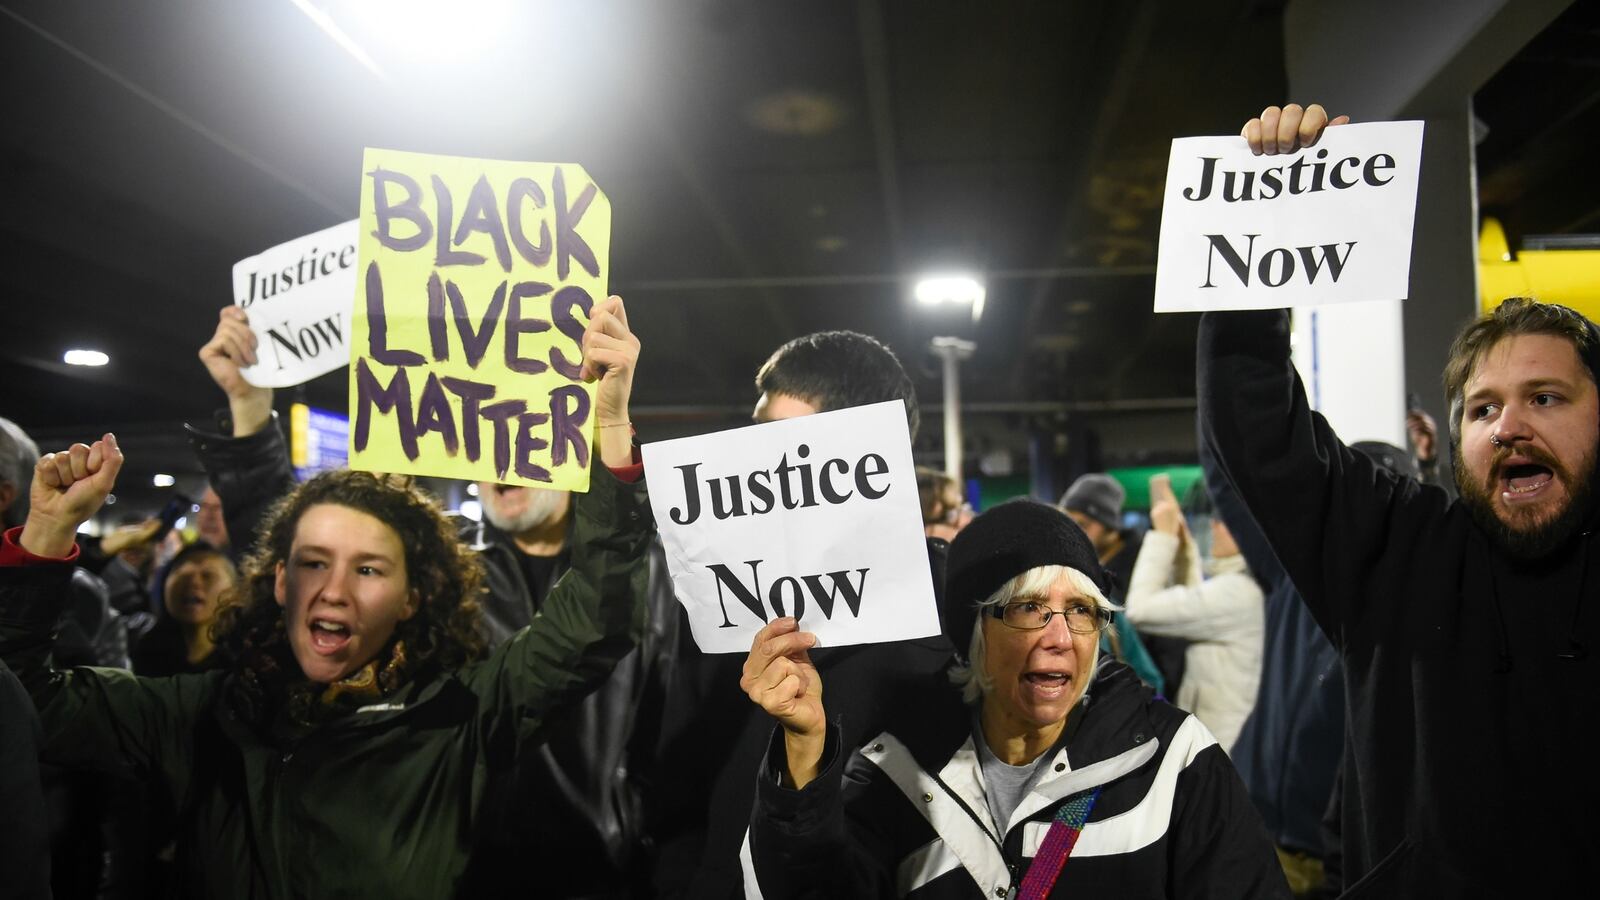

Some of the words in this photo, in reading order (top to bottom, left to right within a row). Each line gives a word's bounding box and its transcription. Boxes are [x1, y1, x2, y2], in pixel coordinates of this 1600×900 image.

[1182, 148, 1396, 203] Justice
[366, 166, 600, 281] BLACK
[240, 244, 356, 309] Justice
[1198, 234, 1358, 288] Now
[267, 313, 342, 370] Now
[366, 260, 595, 382] LIVES
[354, 357, 591, 483] MATTER
[669, 443, 891, 525] Justice
[705, 560, 870, 628] Now
